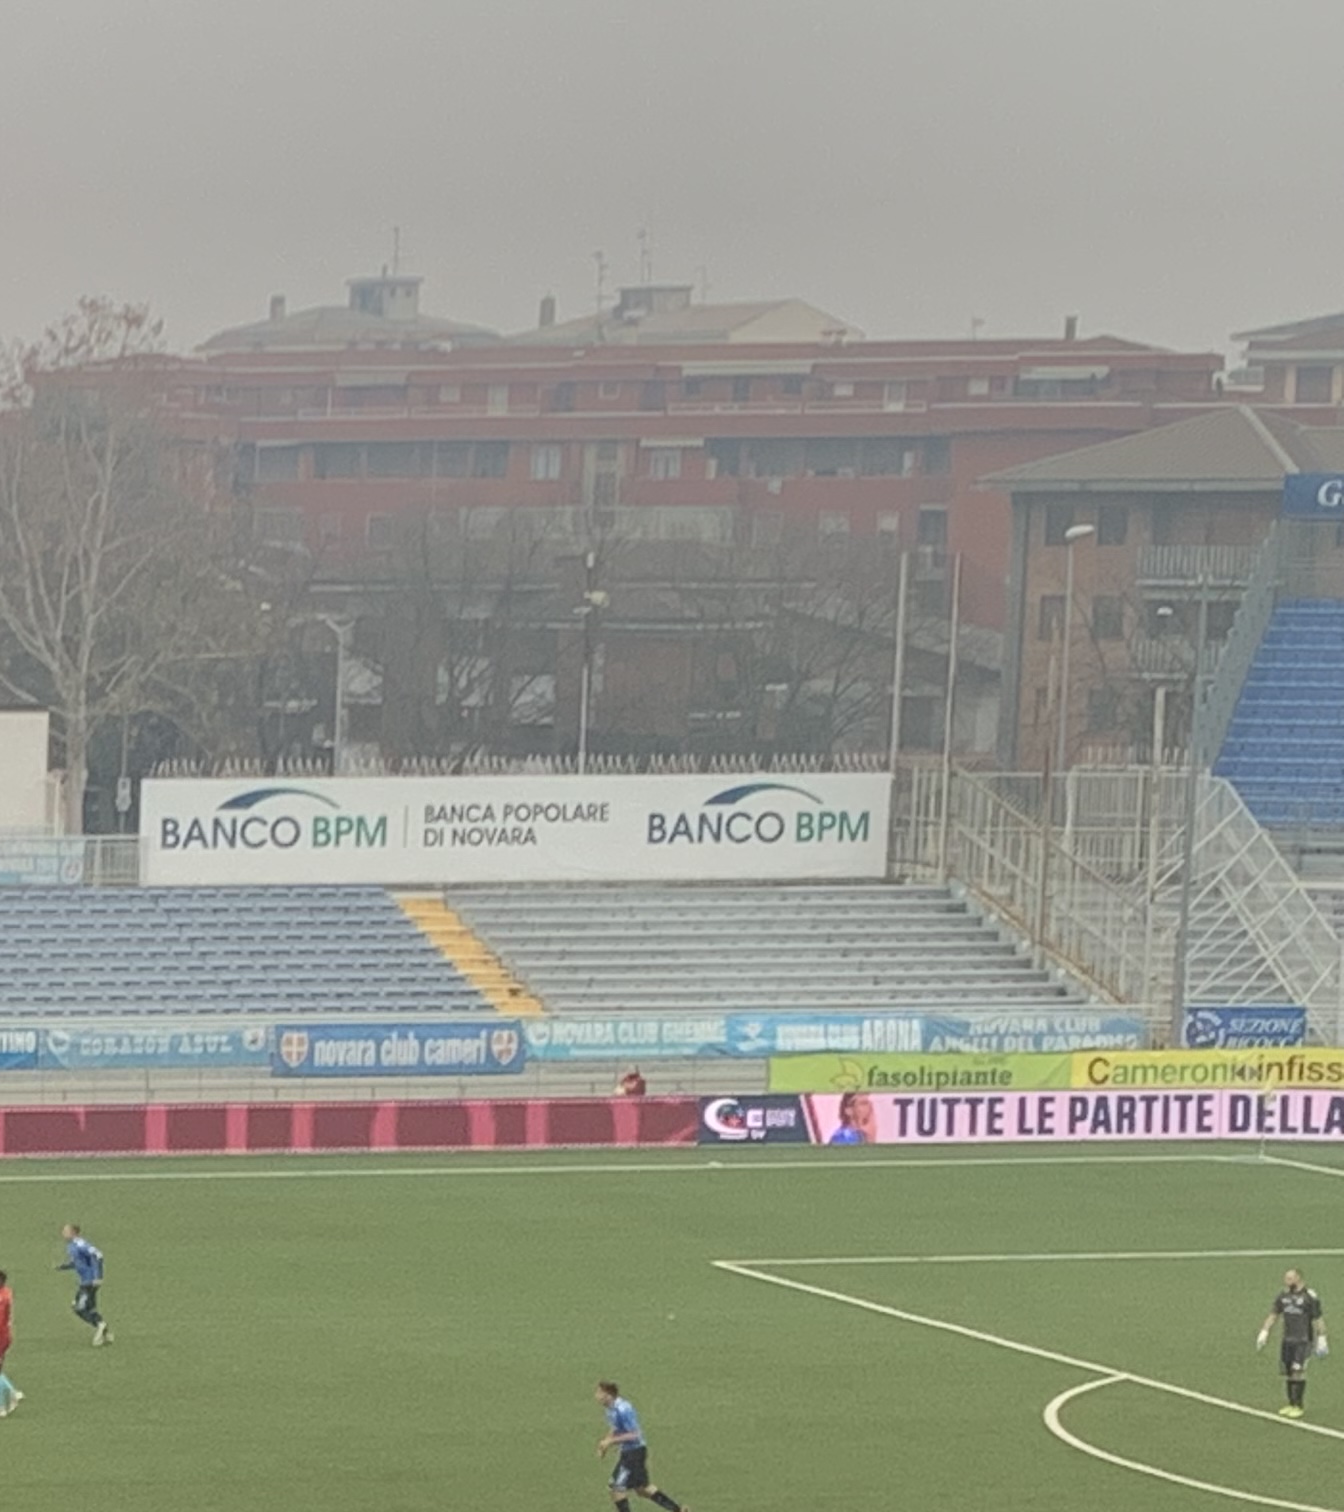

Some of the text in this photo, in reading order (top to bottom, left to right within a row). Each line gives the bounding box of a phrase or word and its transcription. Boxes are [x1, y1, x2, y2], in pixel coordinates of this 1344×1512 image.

[424, 802, 610, 824] BANCA POPOLARE
[647, 811, 870, 844] BANCO BPM
[160, 816, 388, 850] BANCO BPM
[424, 827, 537, 847] DI NOVARA
[1229, 1018, 1304, 1034] SEZIONE
[314, 1028, 486, 1067] novara club cameri
[1088, 1056, 1236, 1085] Cameroni
[893, 1093, 1344, 1138] TUTTE LE PARTITE DELLA
